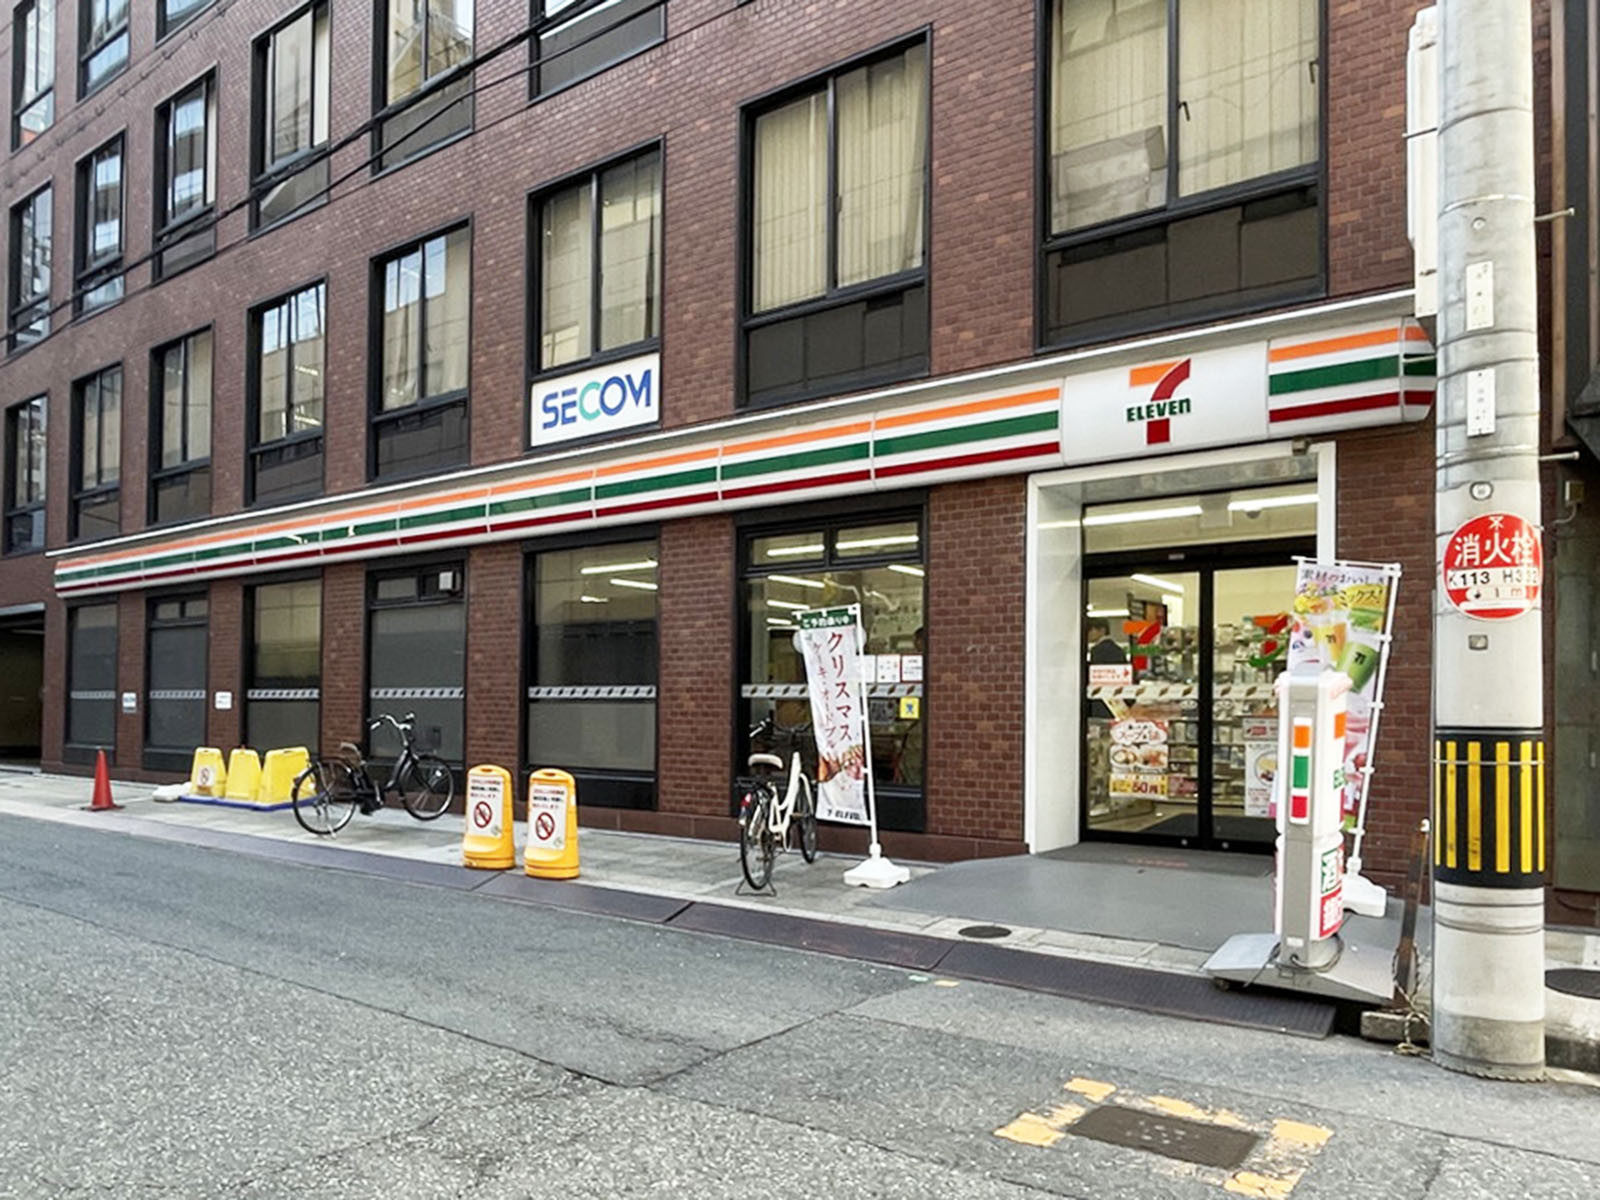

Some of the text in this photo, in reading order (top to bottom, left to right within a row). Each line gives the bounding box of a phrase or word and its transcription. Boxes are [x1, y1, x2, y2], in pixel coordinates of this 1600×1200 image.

[542, 368, 652, 430] SECOM
[1454, 531, 1536, 568] 消火栓
[827, 632, 853, 741] クリスマス
